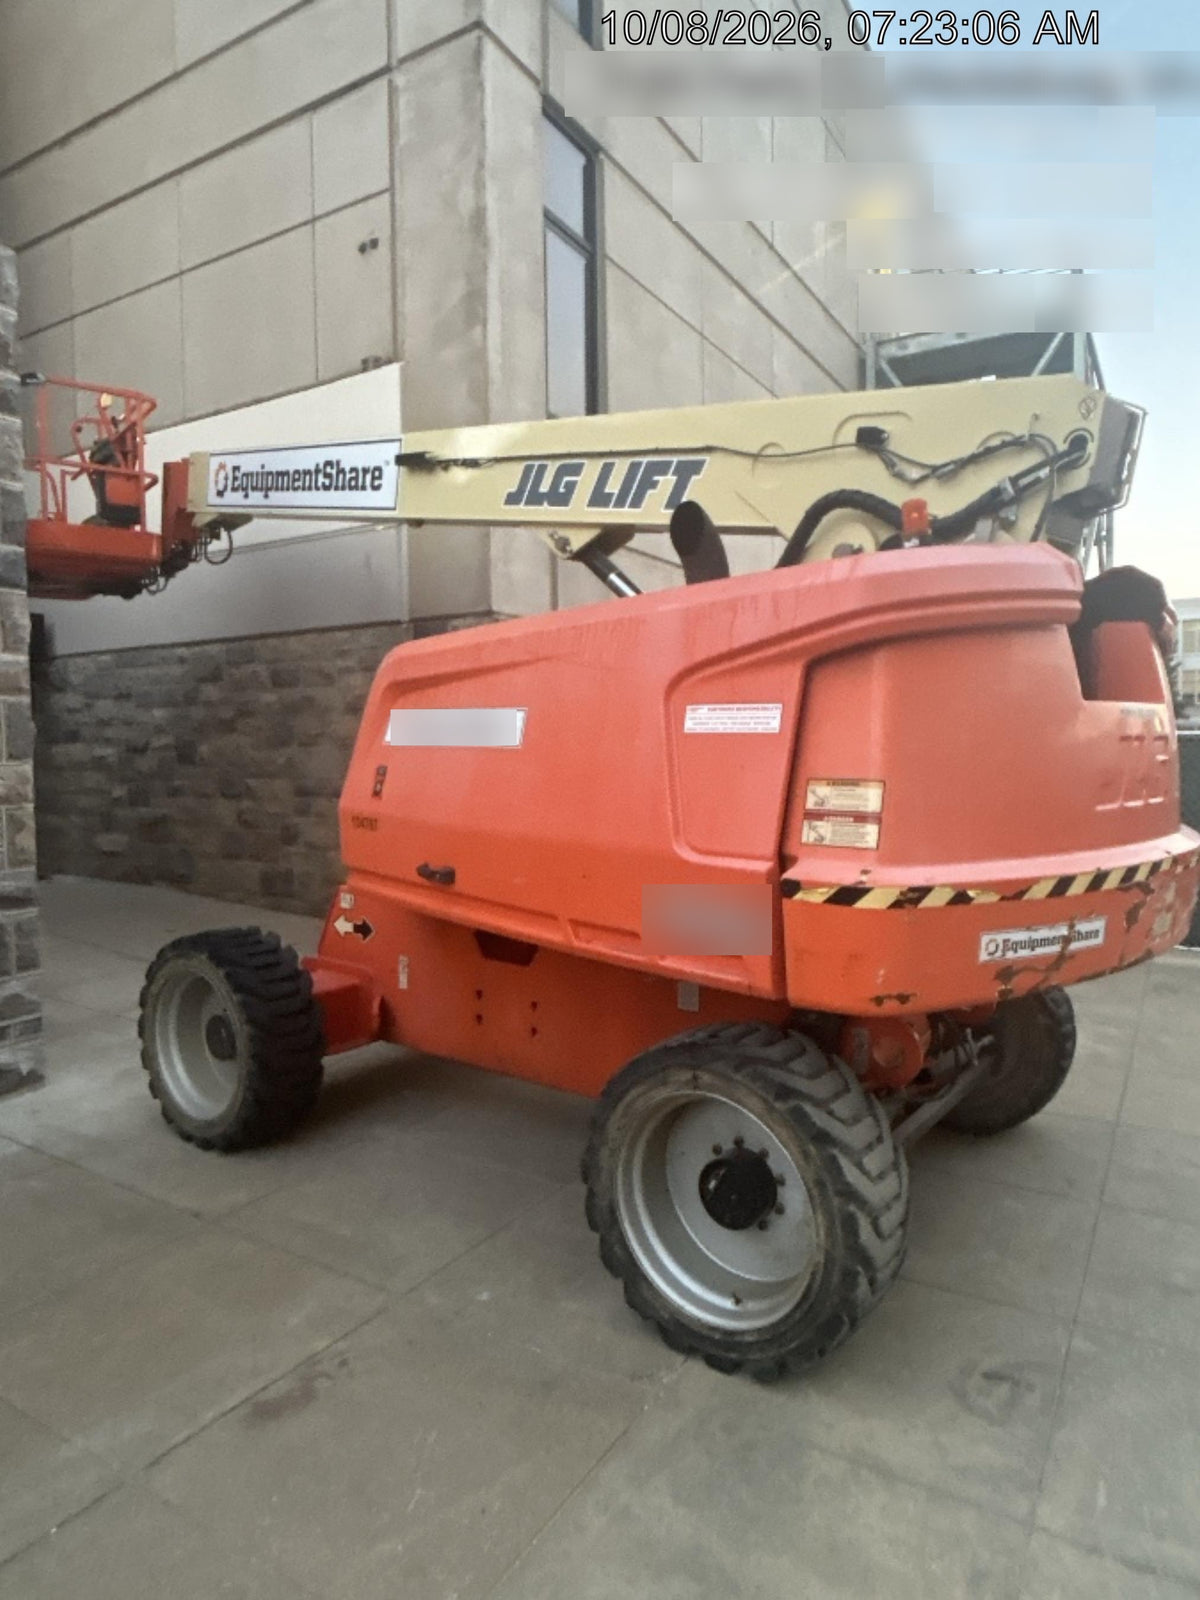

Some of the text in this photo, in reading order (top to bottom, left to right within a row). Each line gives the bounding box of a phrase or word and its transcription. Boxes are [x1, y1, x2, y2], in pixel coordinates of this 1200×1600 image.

[230, 459, 383, 499] EquipmentShare
[503, 457, 709, 512] JLG LIFT
